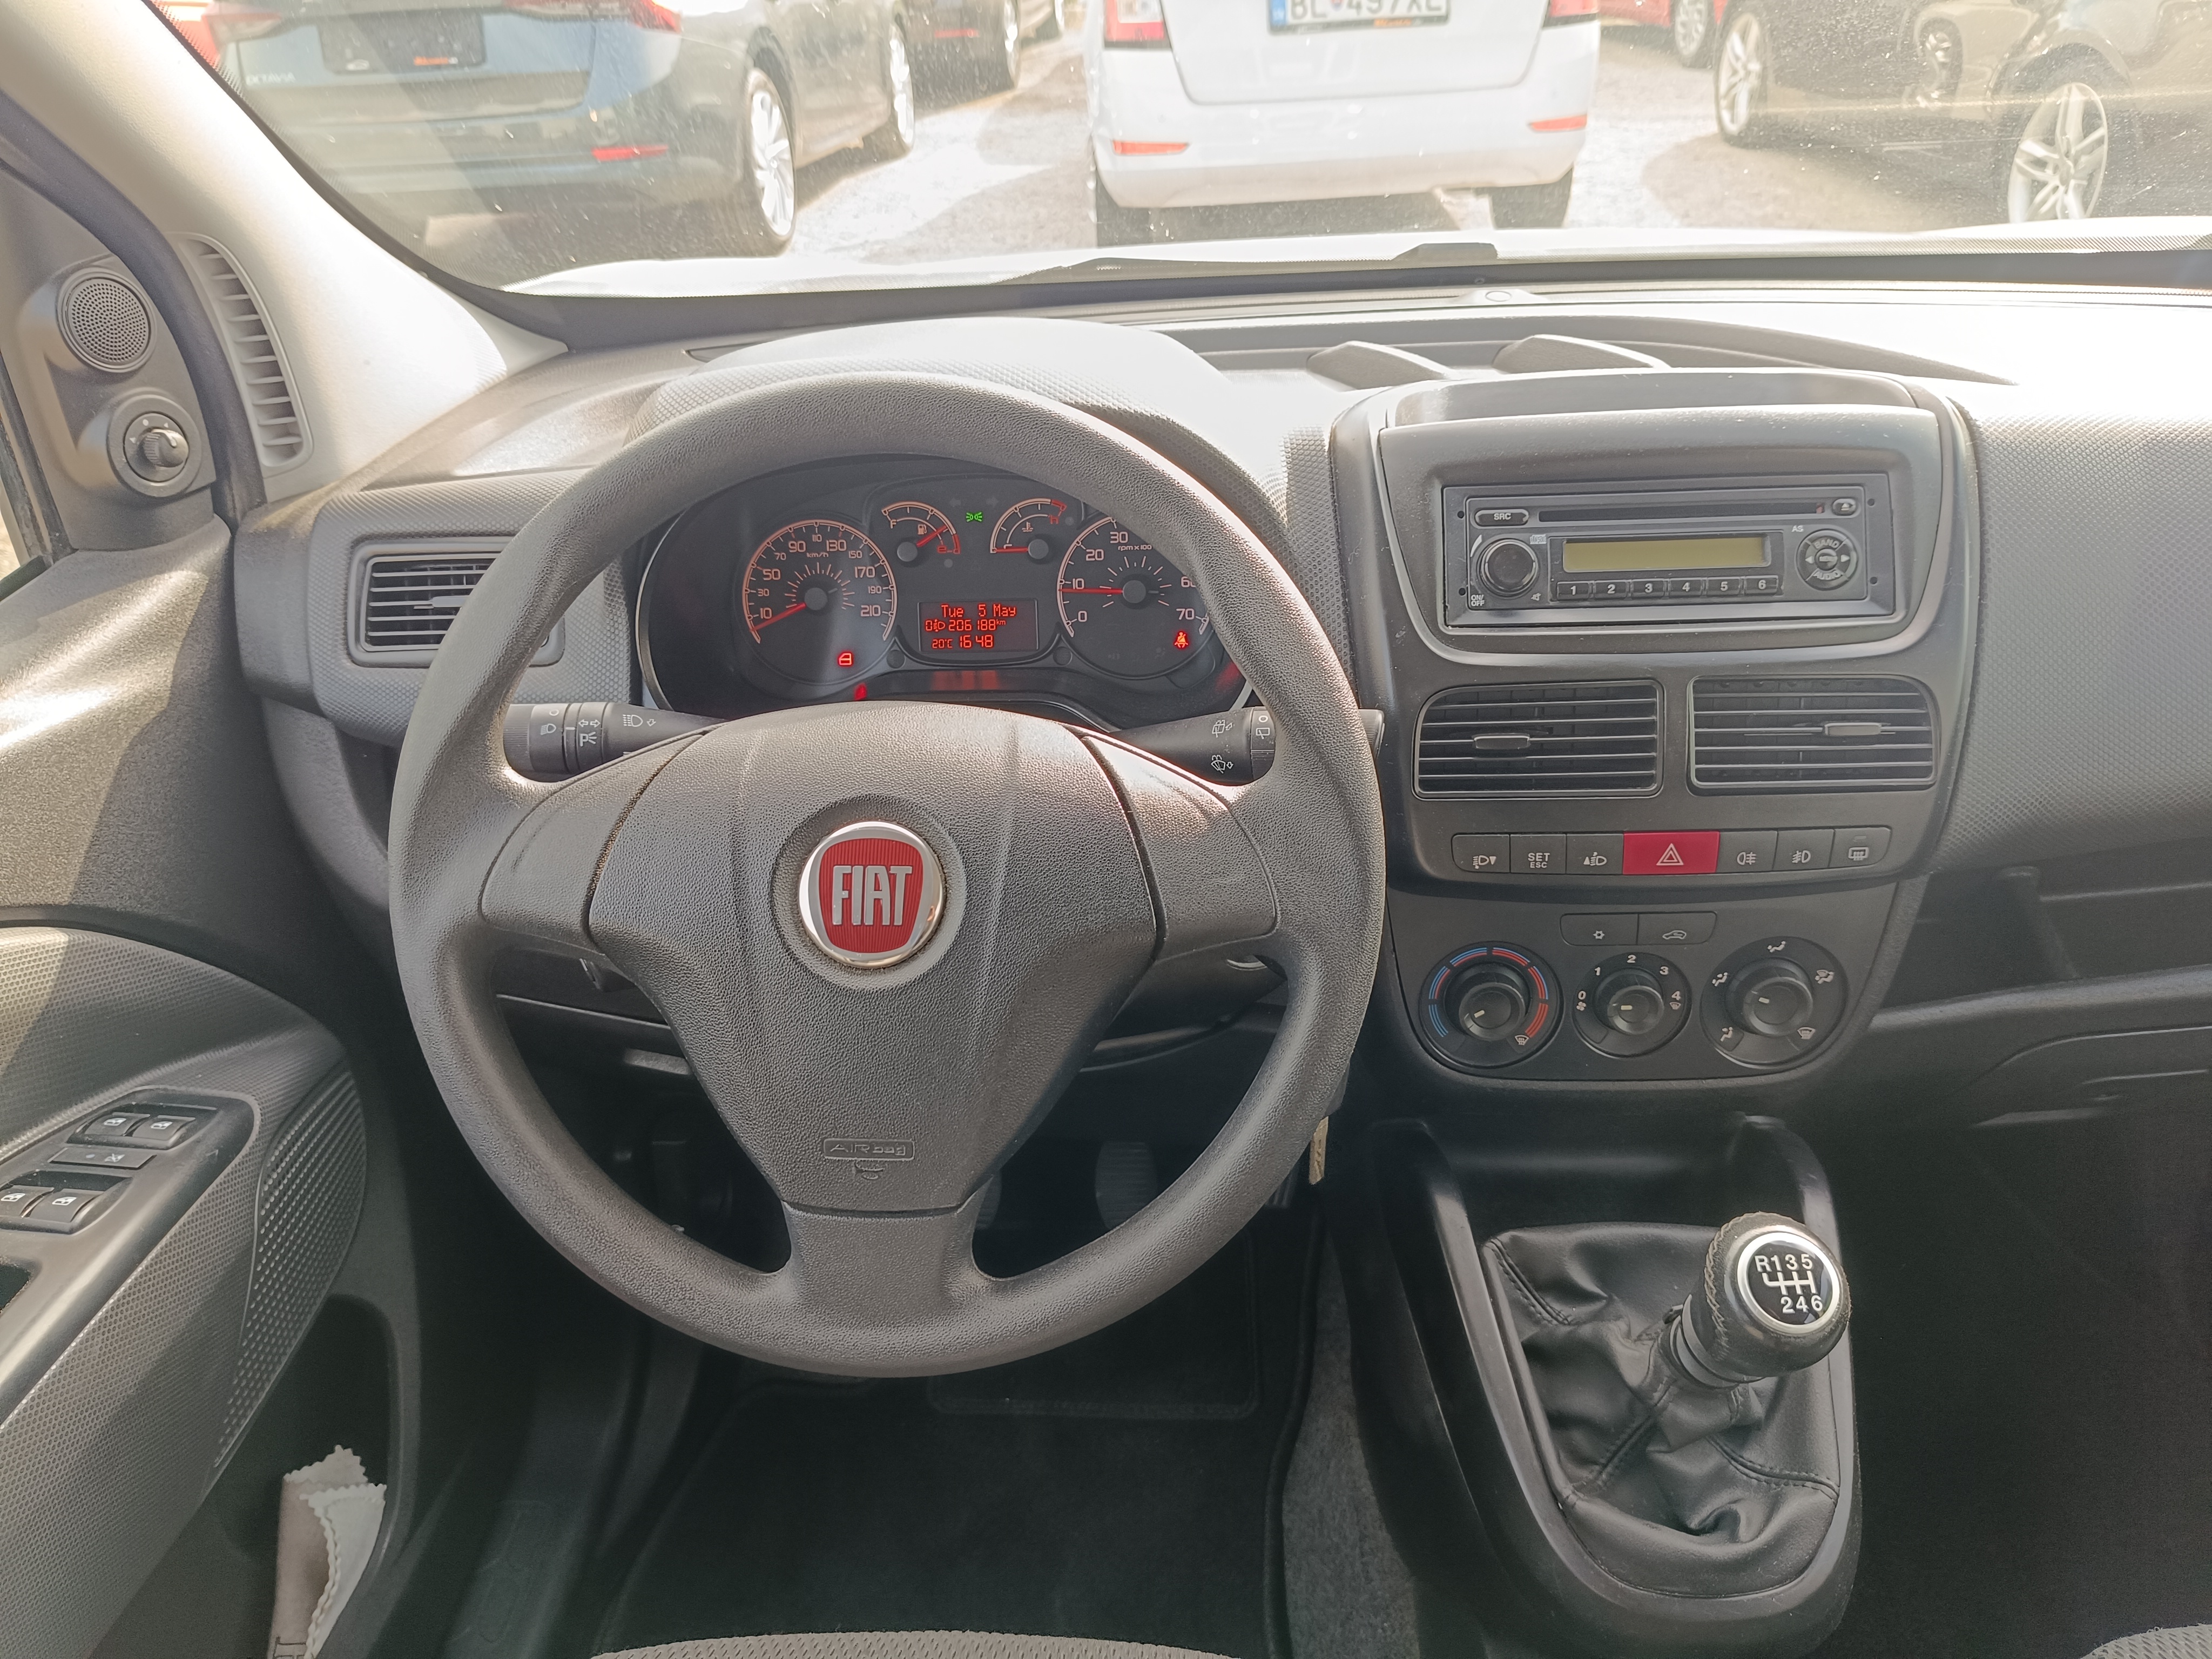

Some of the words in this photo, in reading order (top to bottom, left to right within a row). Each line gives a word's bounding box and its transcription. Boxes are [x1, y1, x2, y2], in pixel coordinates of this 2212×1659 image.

[1110, 531, 1128, 543] 30
[788, 541, 806, 552] 90
[826, 539, 847, 551] 130
[1814, 539, 1840, 549] BAND
[1086, 549, 1104, 561] 20
[763, 569, 781, 580] 50
[854, 567, 875, 578] 170
[1073, 578, 1084, 590] 10
[1570, 586, 1576, 595] 1
[1607, 584, 1615, 594] 2
[1645, 583, 1653, 592] 3
[1682, 582, 1690, 591] 4
[1720, 581, 1728, 591] 5
[1758, 579, 1766, 589] 6
[760, 608, 772, 619] 10
[860, 605, 881, 616] 210
[941, 604, 964, 617] Tue
[978, 604, 986, 617] 5
[993, 604, 1016, 617] May
[1176, 608, 1195, 620] 70
[1078, 611, 1088, 622] 0
[1528, 852, 1550, 861] SET
[832, 865, 913, 926] FIAT
[1627, 954, 1636, 963] 2
[1594, 967, 1601, 976] 1
[1660, 966, 1669, 975] 3
[1578, 990, 1586, 1000] 0
[1671, 991, 1681, 1000] 4
